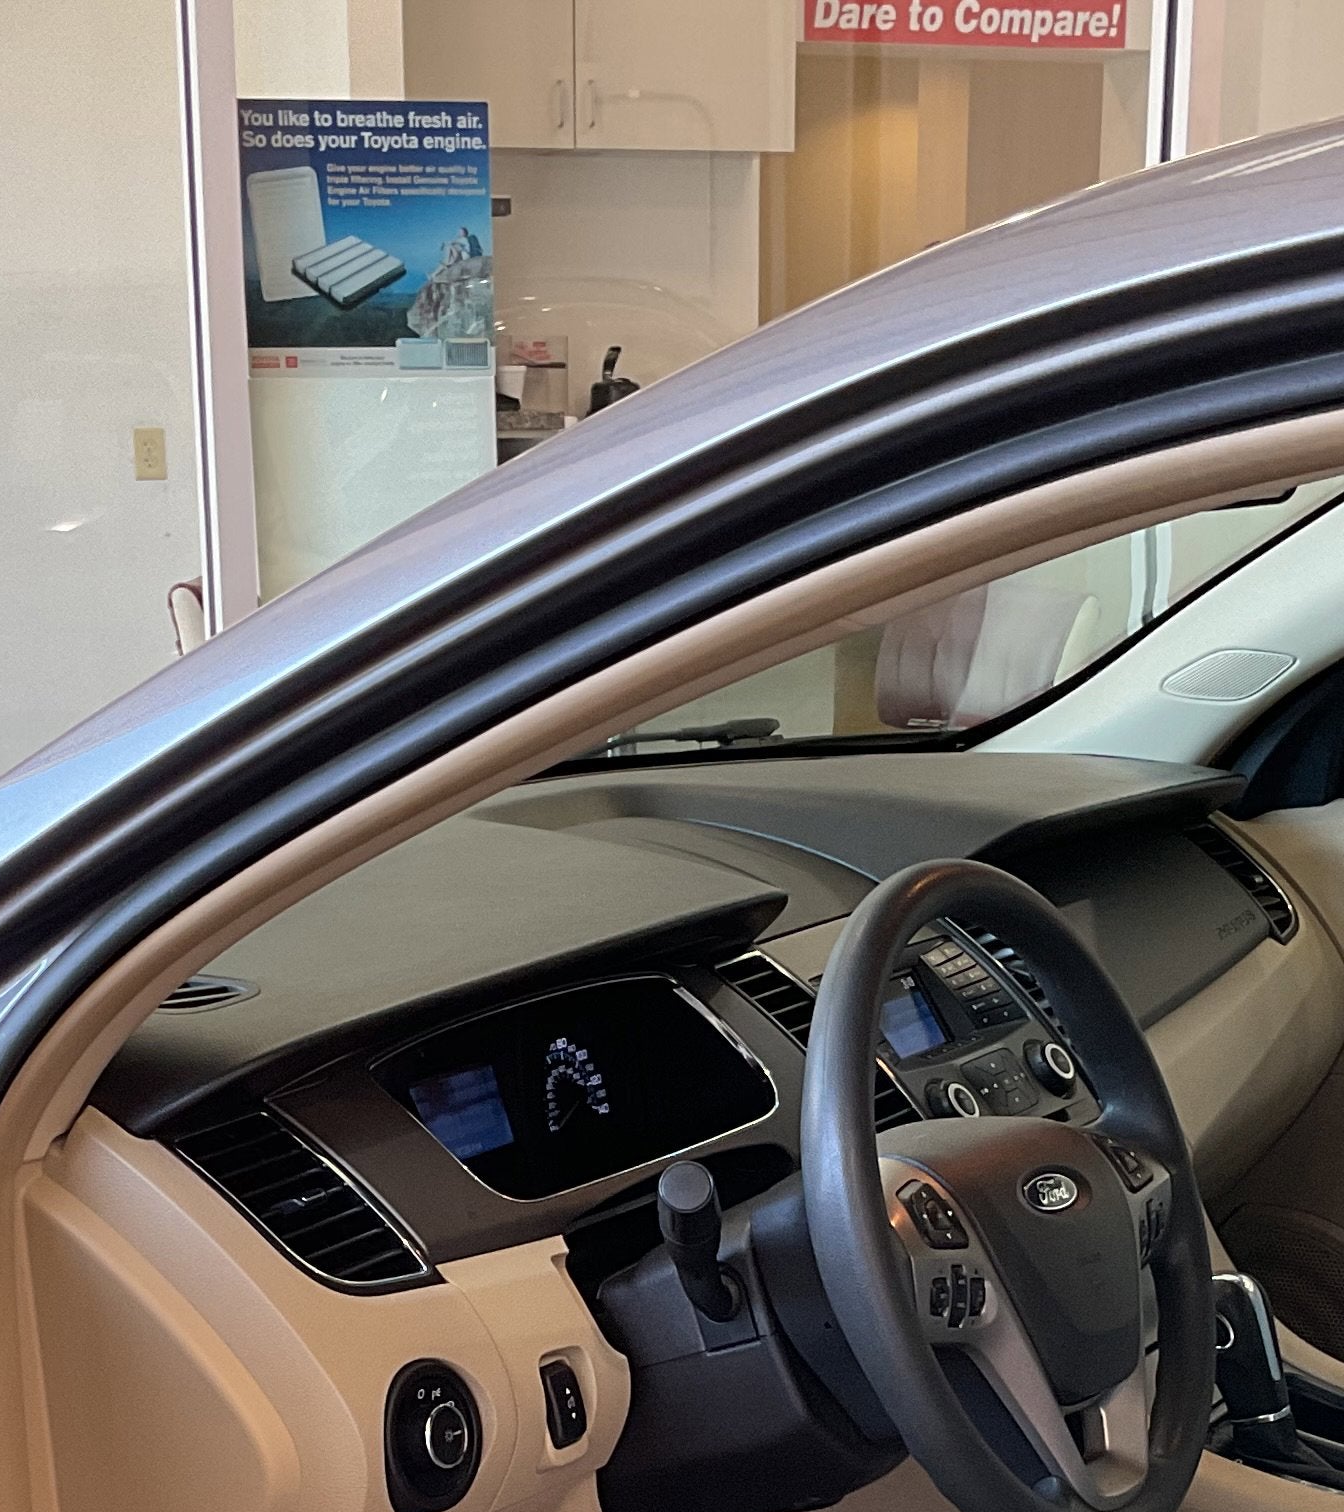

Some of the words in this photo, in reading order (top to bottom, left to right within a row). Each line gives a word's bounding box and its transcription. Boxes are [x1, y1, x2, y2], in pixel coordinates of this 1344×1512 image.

[814, 0, 897, 31] Dare
[909, 0, 944, 32] to
[955, 0, 1121, 43] Compare!
[240, 109, 274, 127] You
[277, 109, 310, 127] like
[314, 110, 332, 127] to
[336, 110, 405, 128] breathe
[408, 111, 452, 129] fresh
[456, 112, 483, 129] air.
[242, 130, 267, 148] So
[271, 130, 315, 148] does
[318, 134, 357, 151] your
[360, 131, 419, 152] Toyota
[423, 132, 487, 152] engine.
[1037, 1179, 1070, 1205] Ford
